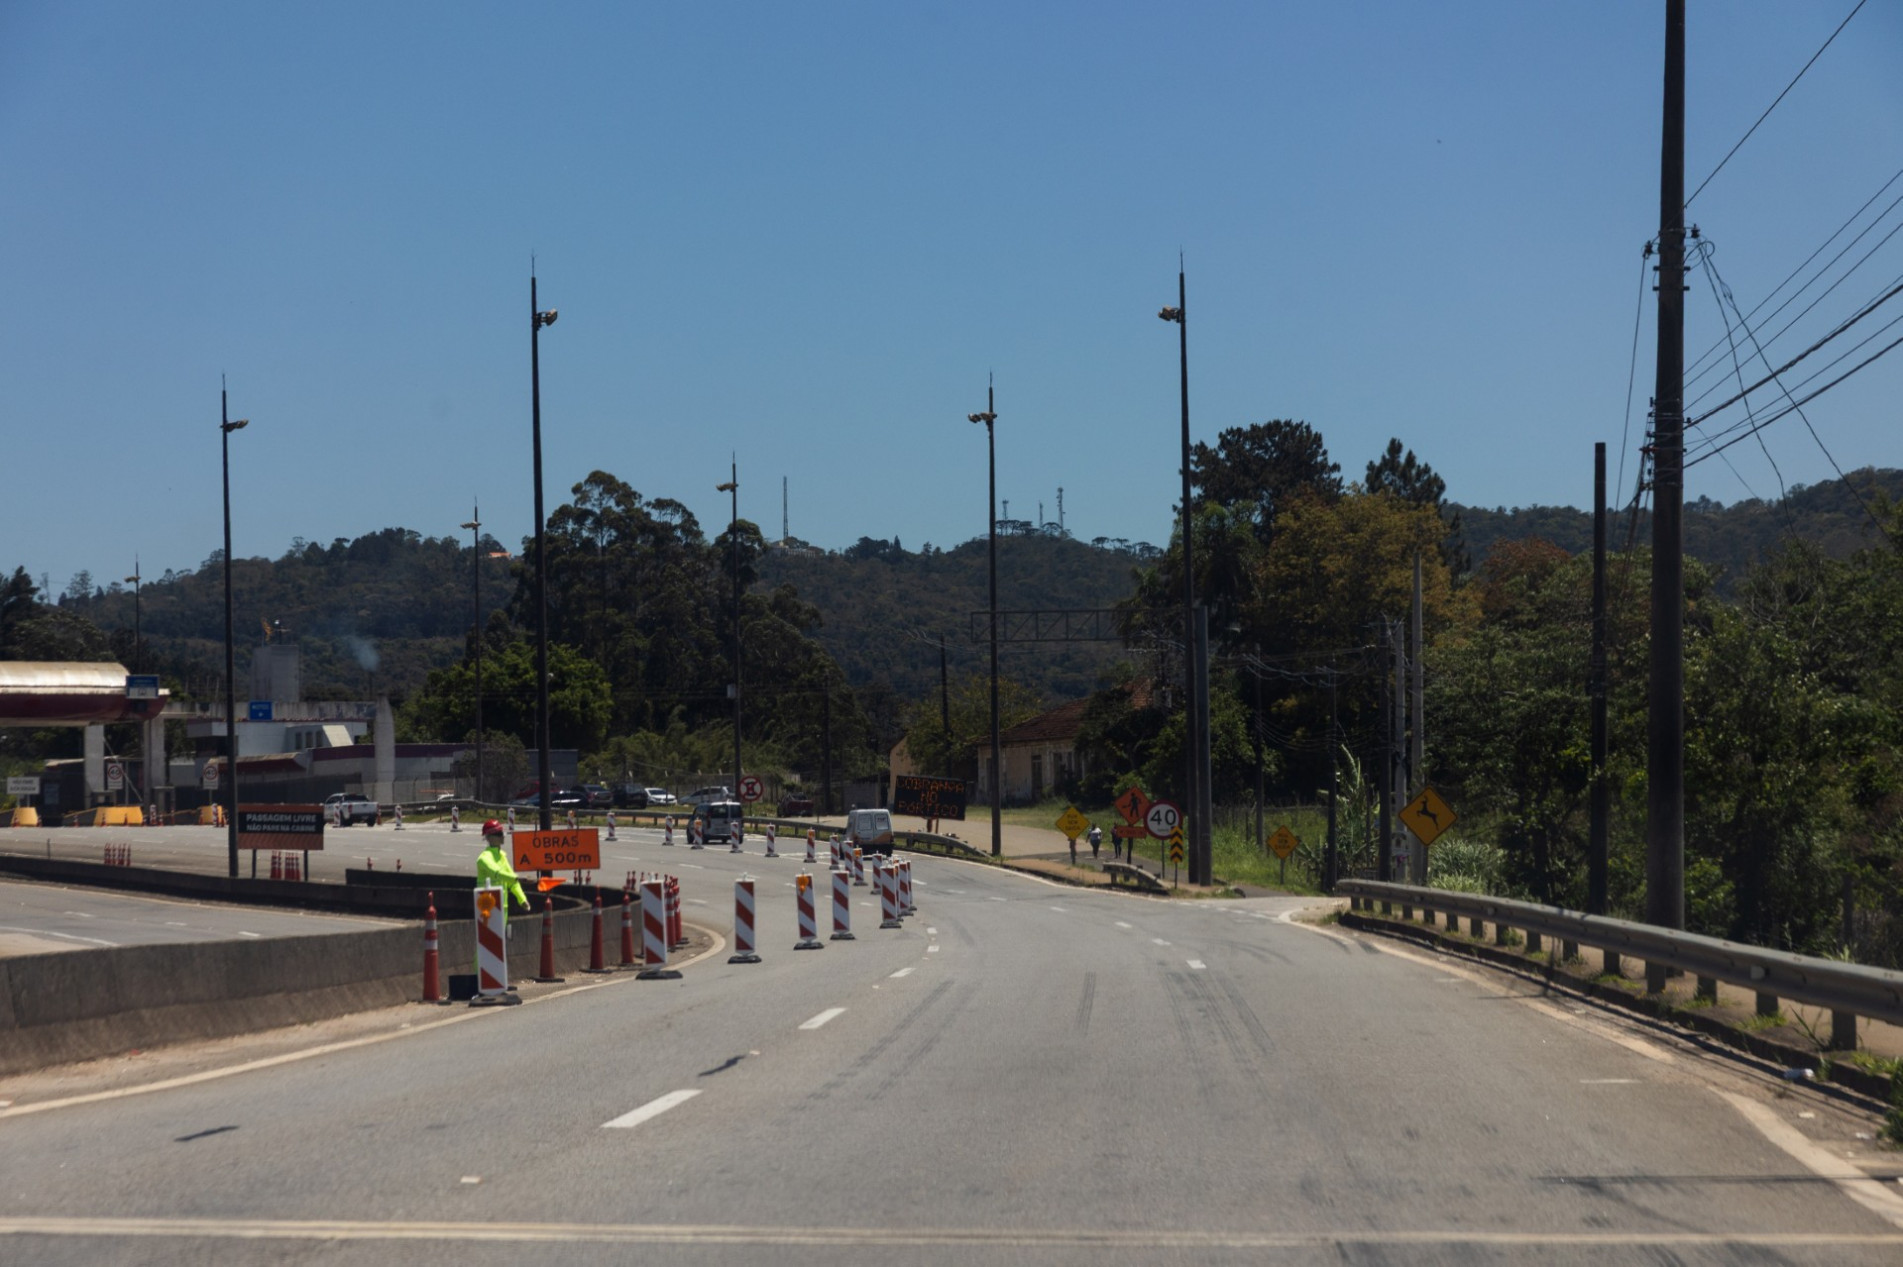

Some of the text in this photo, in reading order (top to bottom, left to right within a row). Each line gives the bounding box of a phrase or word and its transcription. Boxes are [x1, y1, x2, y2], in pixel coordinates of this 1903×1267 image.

[246, 813, 317, 823] PASSAGEM LIVRE
[1150, 809, 1177, 826] 40
[246, 823, 262, 832] NÃO
[532, 835, 579, 848] OBRAS
[519, 851, 592, 865] A 500m
